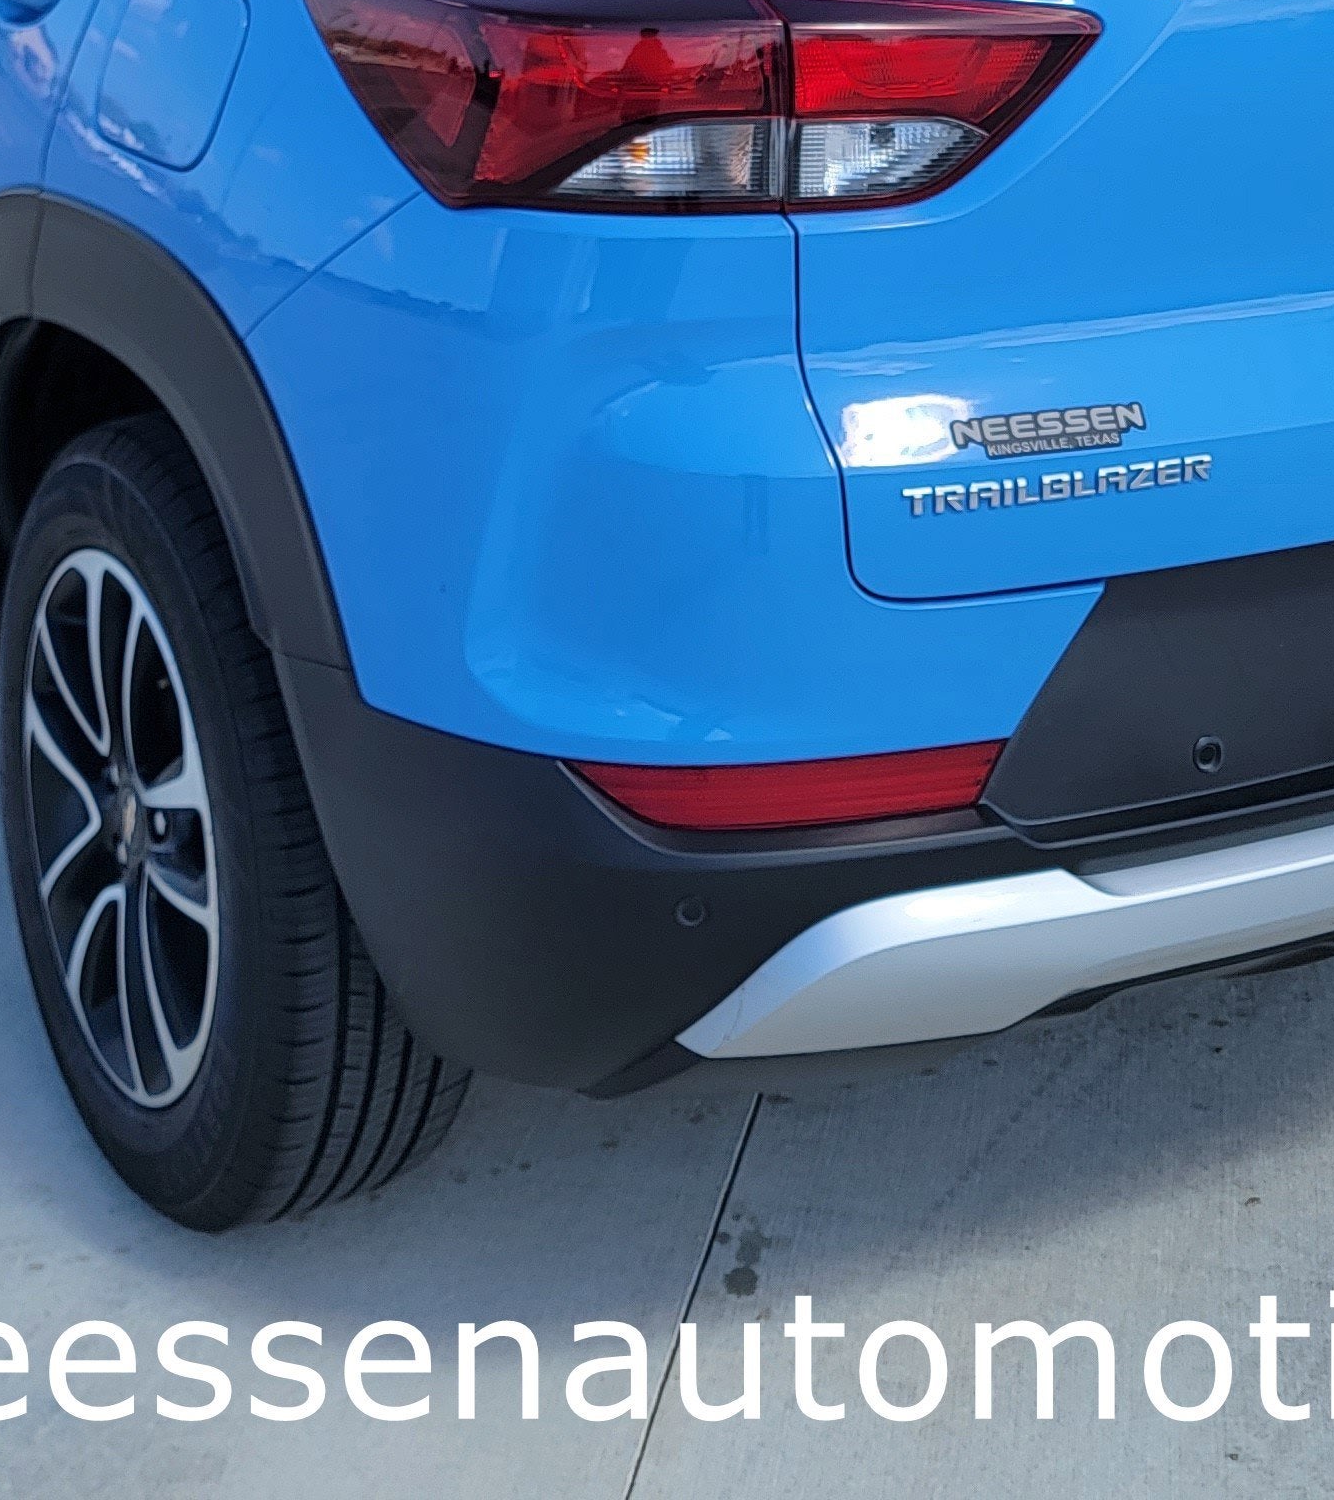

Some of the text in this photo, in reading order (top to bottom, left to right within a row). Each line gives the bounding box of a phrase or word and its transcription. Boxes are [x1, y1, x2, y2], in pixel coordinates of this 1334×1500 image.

[951, 403, 1145, 447] NEESSEN
[987, 432, 1121, 457] KINGSVILLE, TEXAS
[902, 453, 1214, 517] TRAILBLAZER
